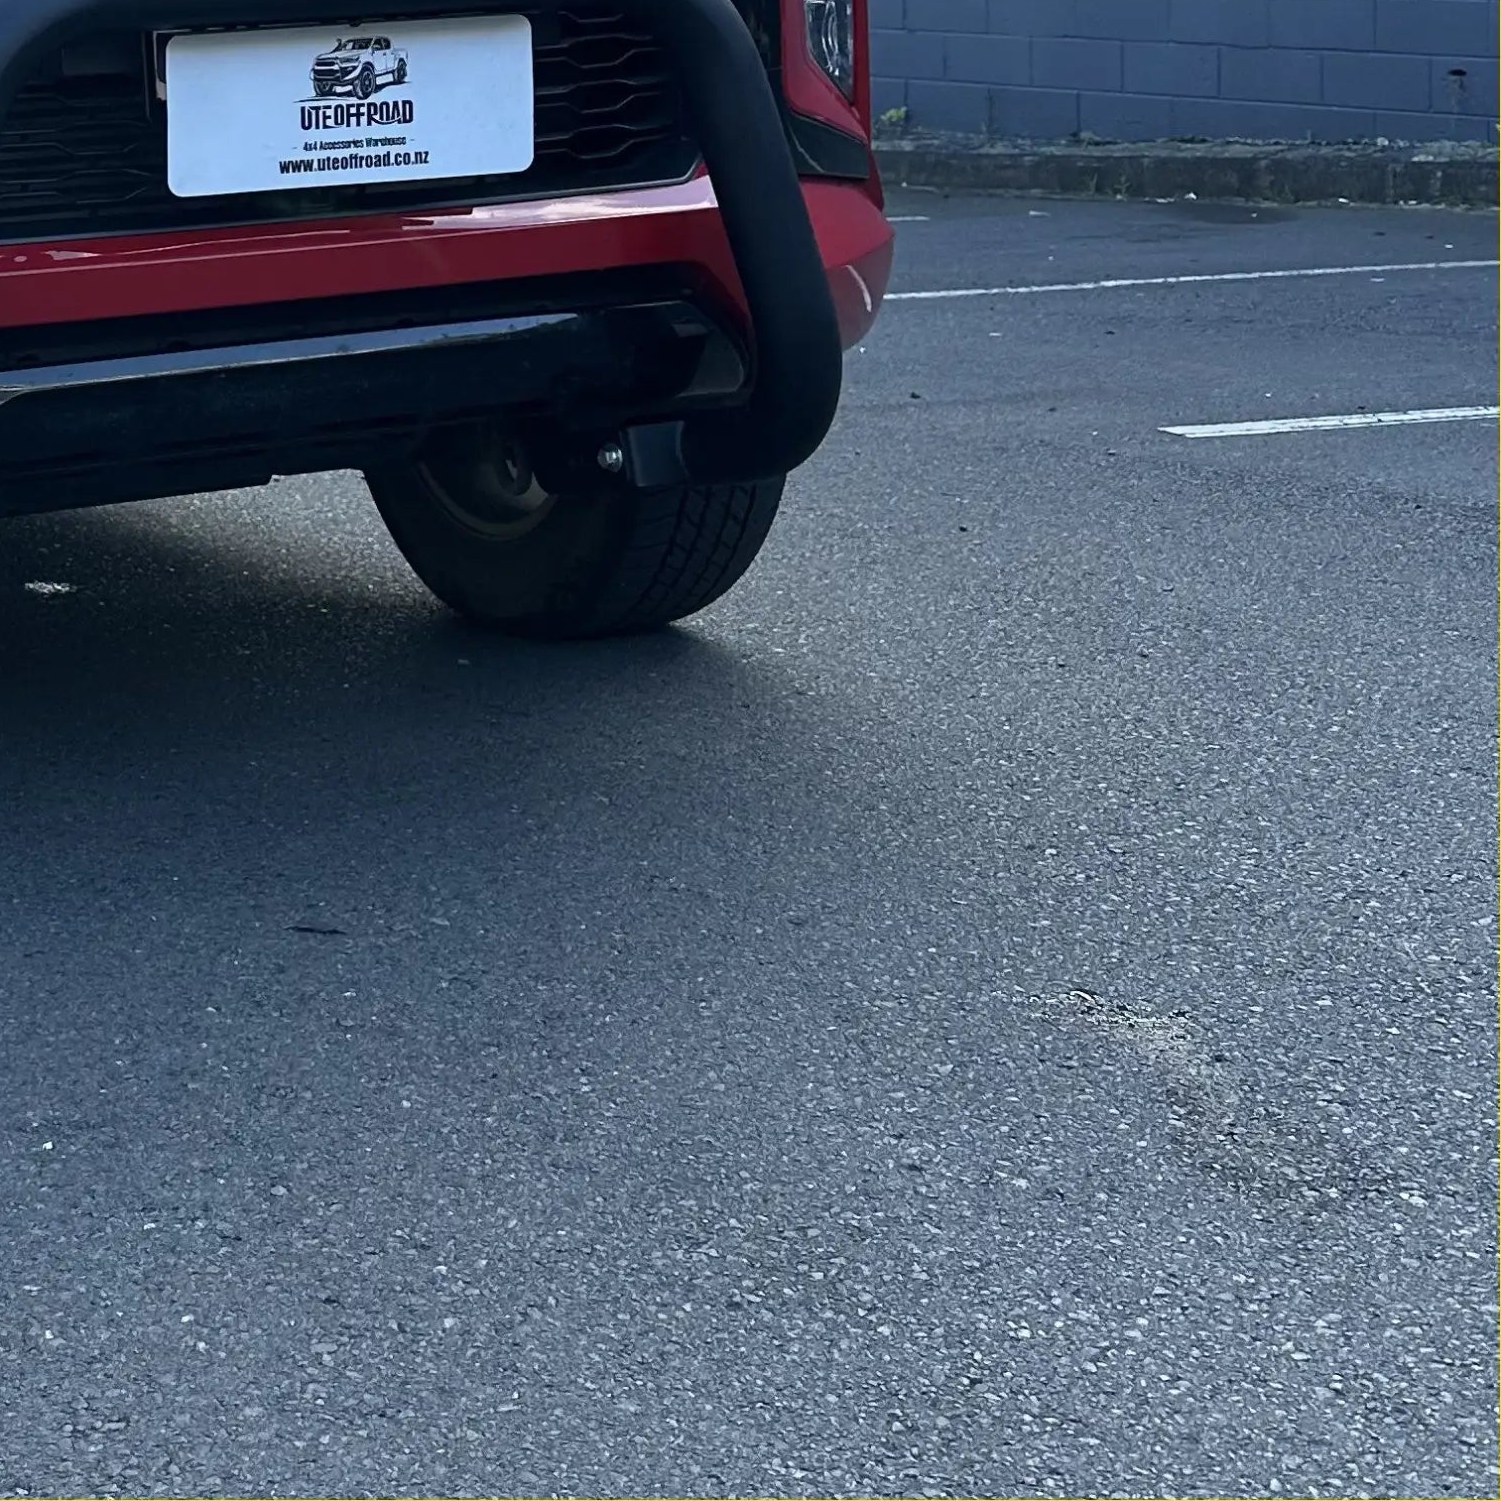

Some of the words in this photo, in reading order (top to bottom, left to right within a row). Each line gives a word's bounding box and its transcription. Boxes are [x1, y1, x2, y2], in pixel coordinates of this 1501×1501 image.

[300, 99, 414, 131] UTEOFFROAD
[302, 141, 318, 152] 4x4
[319, 138, 364, 151] Accessories
[365, 136, 407, 148] Warehouse
[279, 150, 430, 174] www.uteoffroad.co.nz
